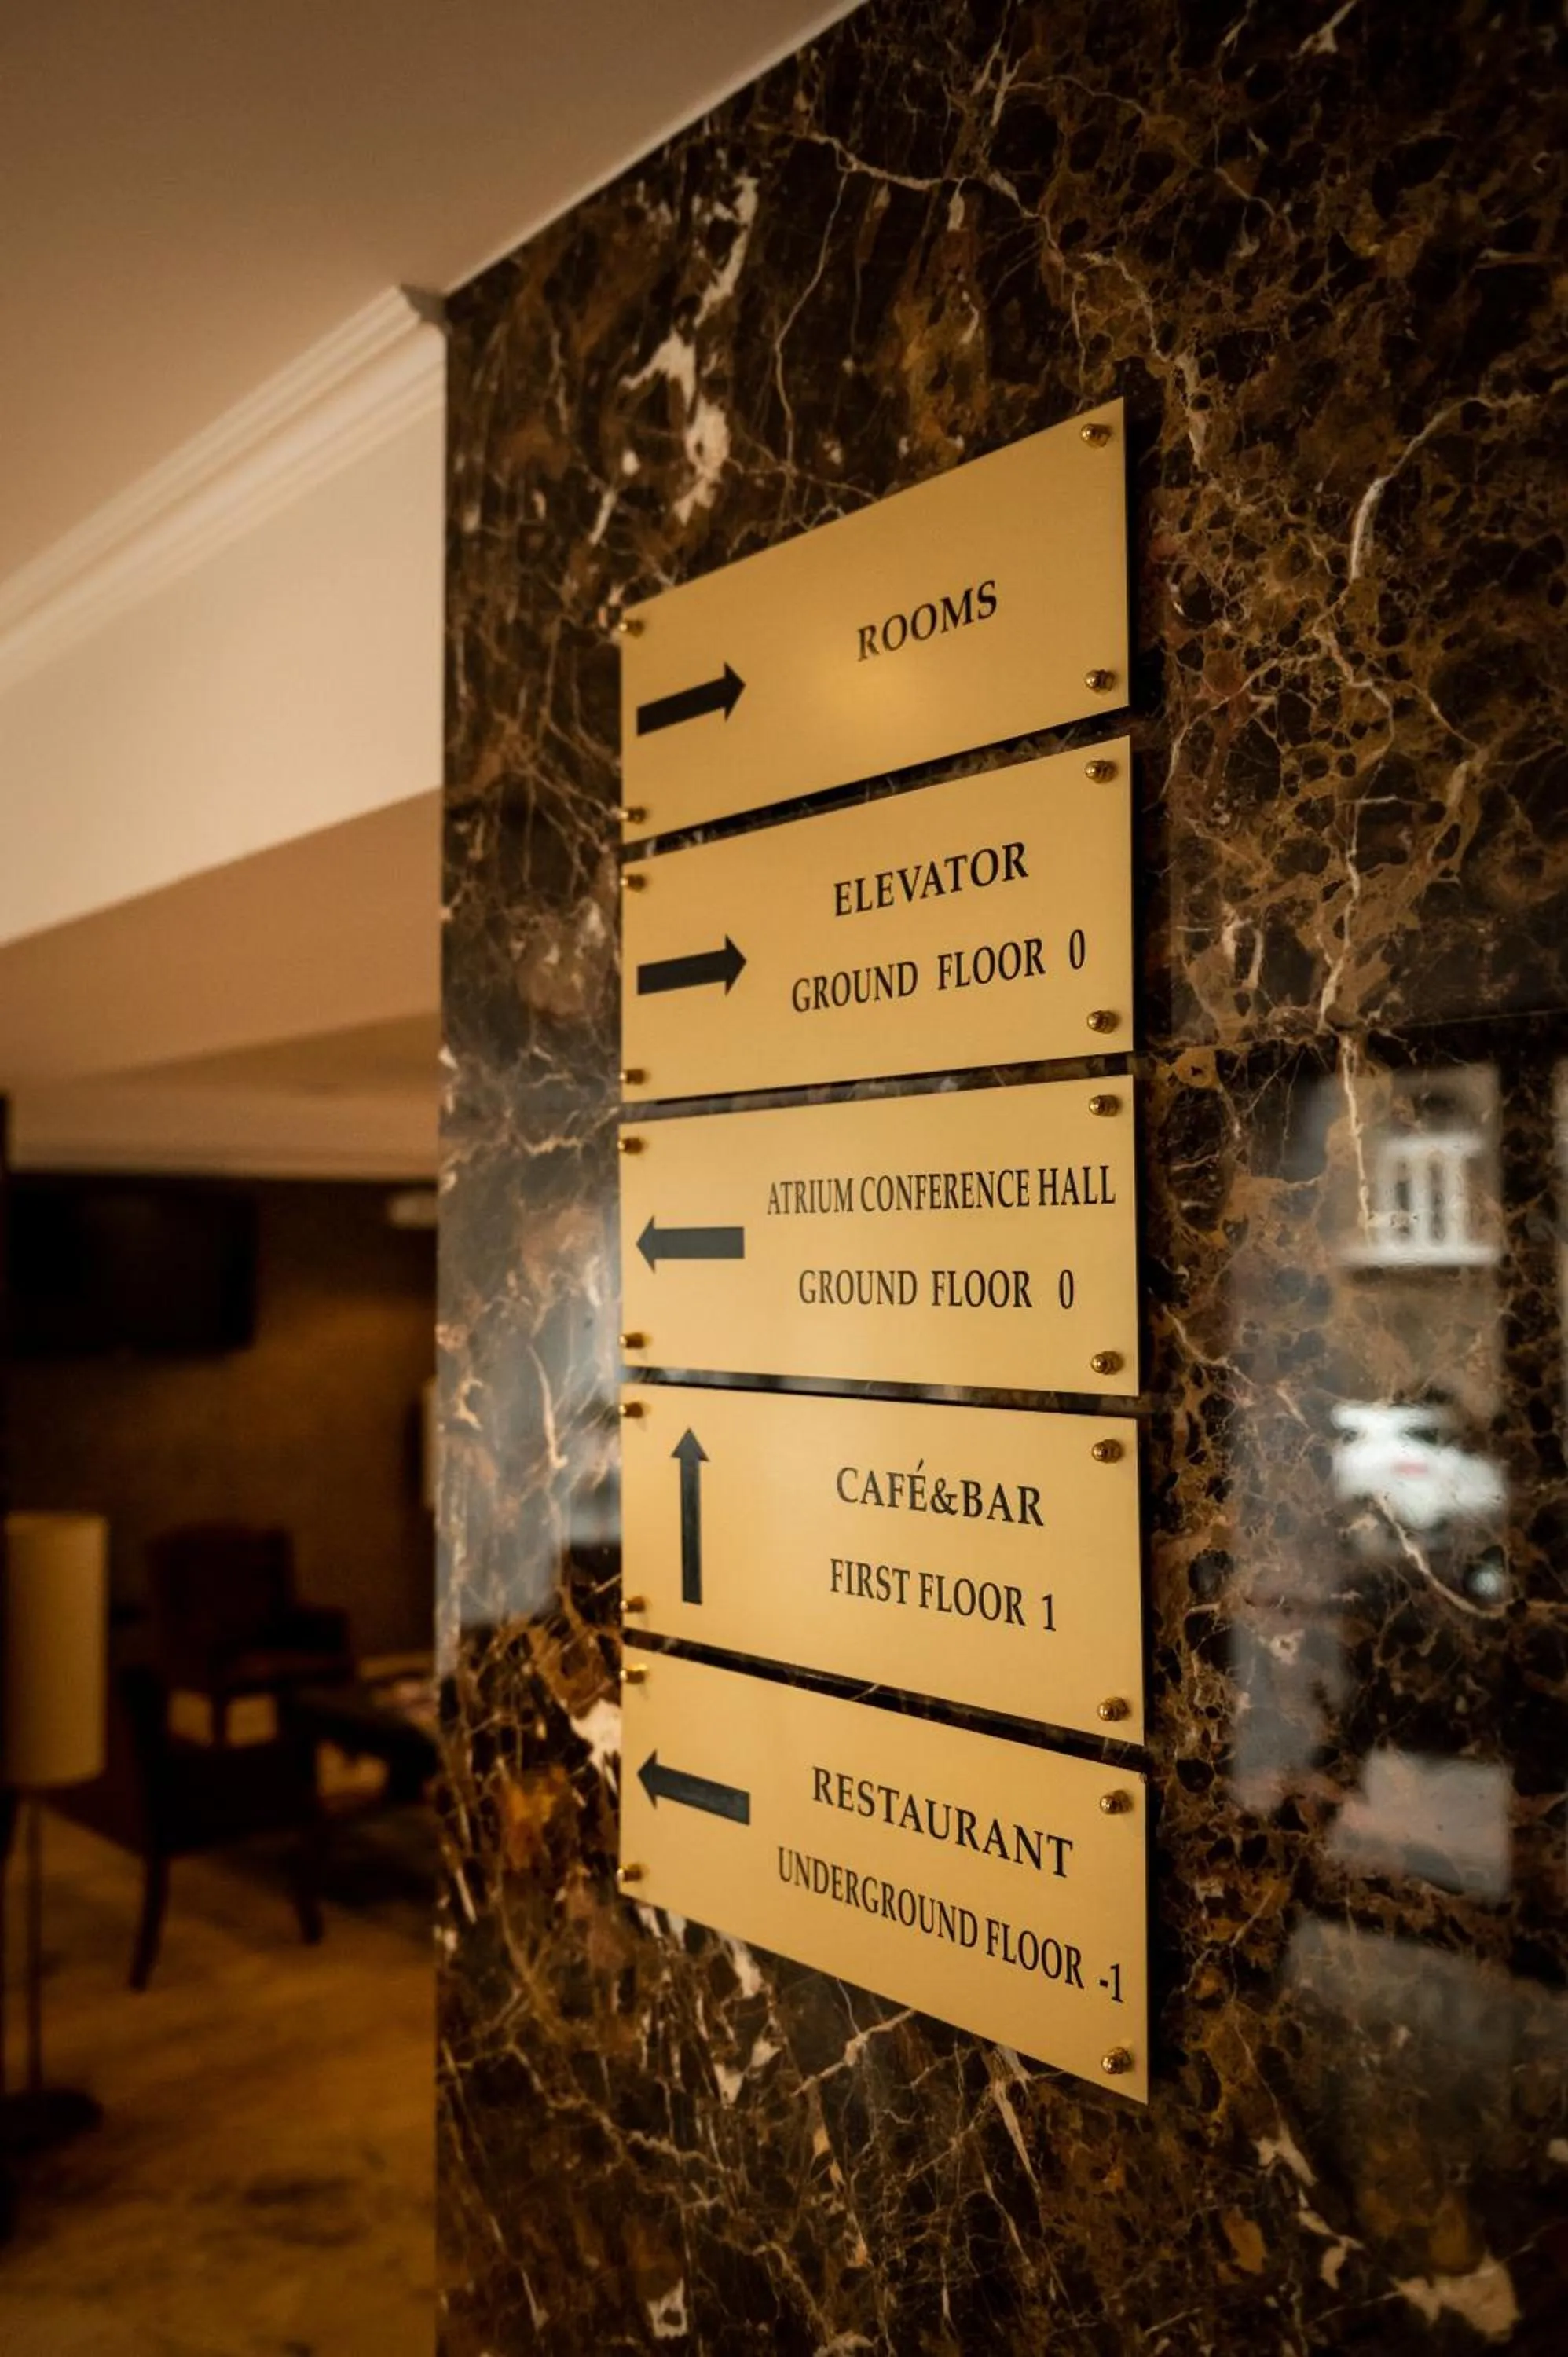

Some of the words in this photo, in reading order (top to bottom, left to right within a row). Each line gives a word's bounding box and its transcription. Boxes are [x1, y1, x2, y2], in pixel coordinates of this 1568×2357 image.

[857, 579, 998, 661] ROOMS
[833, 841, 1030, 918] ELEVATOR
[792, 960, 918, 1014] GROUND
[937, 937, 1046, 992] FLOOR
[1068, 928, 1086, 970] 0
[767, 1177, 854, 1215] ATRIUM
[859, 1168, 1030, 1213] CONFERENCE
[1037, 1164, 1116, 1207] HALL
[798, 1269, 918, 1306] GROUND
[931, 1269, 1033, 1309] FLOOR
[1058, 1268, 1075, 1310] 0
[836, 1458, 1045, 1527] CAFÉ&BAR
[830, 1556, 911, 1605] FIRST
[918, 1571, 1027, 1627] FLOOR
[1041, 1593, 1057, 1633] 1
[812, 1766, 1074, 1879] RESTAURANT
[778, 1846, 979, 1948] UNDERGROUND
[985, 1917, 1086, 1990] FLOOR
[1098, 1963, 1125, 2004] -1
